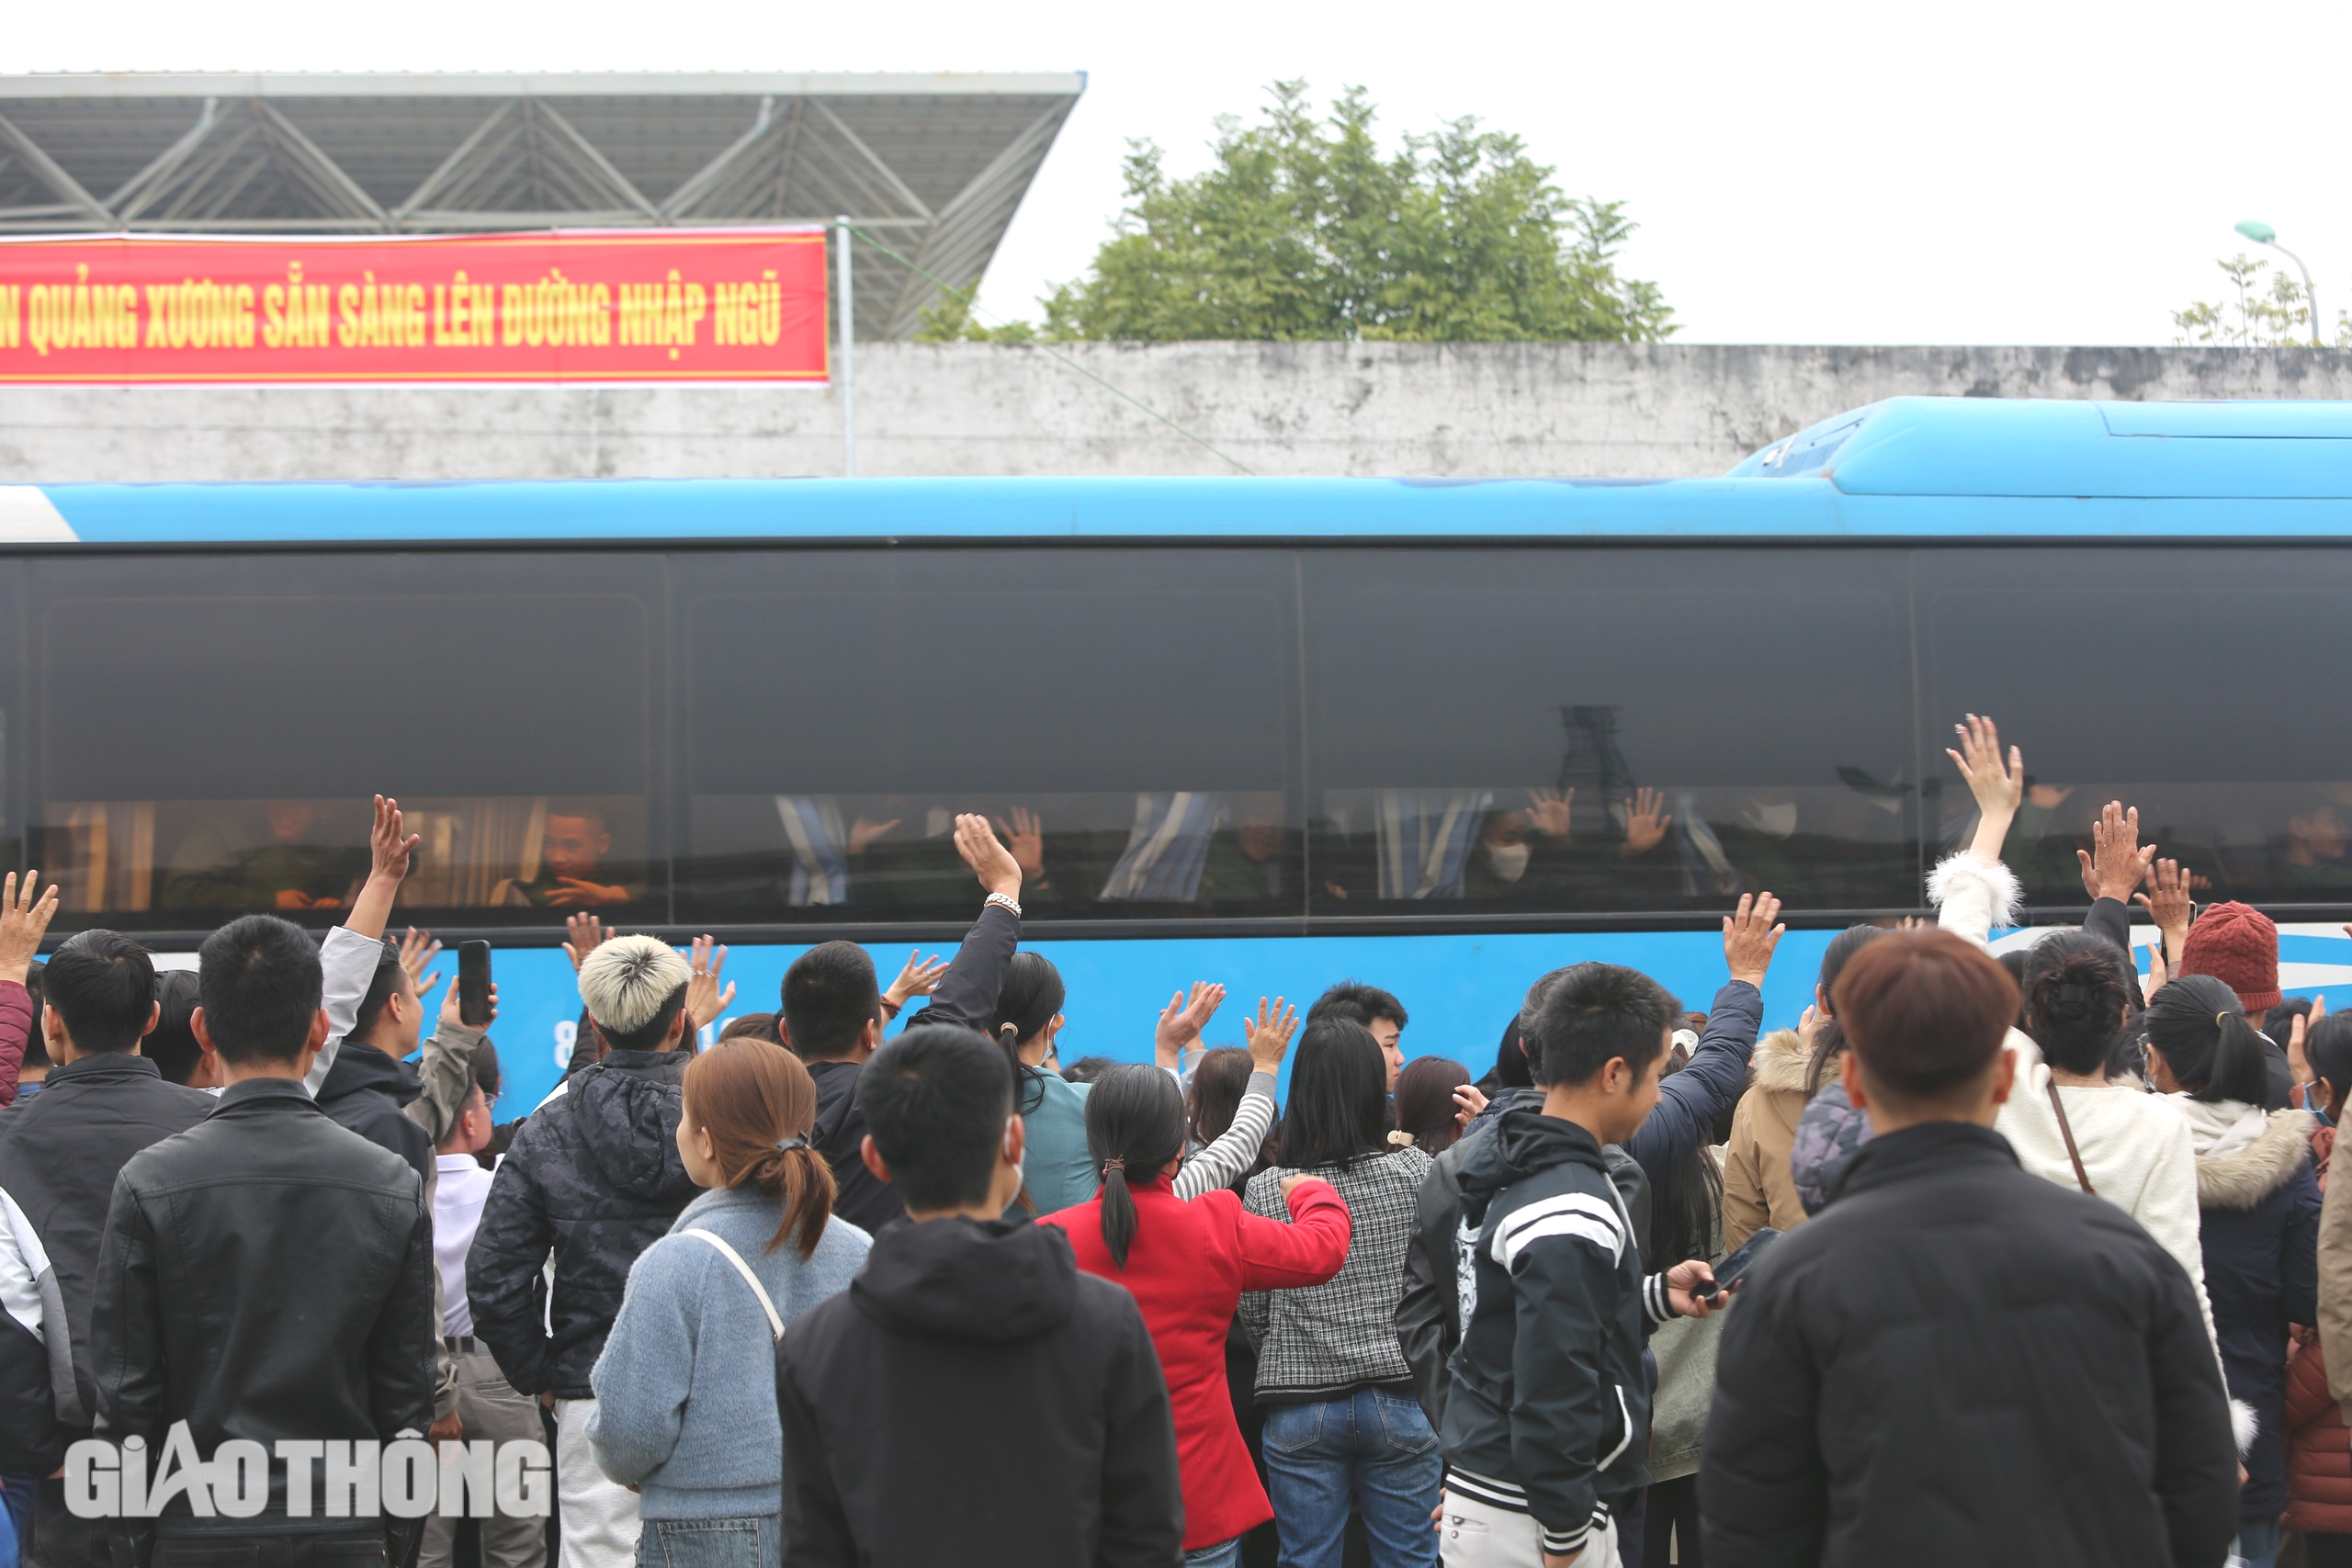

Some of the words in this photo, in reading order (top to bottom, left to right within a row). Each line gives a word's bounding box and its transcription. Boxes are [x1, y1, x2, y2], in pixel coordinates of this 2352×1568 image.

[28, 262, 139, 356] QUẢNG
[144, 277, 255, 348] XƯƠNG
[263, 260, 330, 348] SẴN
[337, 269, 425, 348] SÀNG
[434, 270, 494, 347] LÊN
[502, 267, 611, 347] ĐƯỜNG
[619, 268, 707, 361] NHẬP
[714, 269, 781, 346] NGŨ
